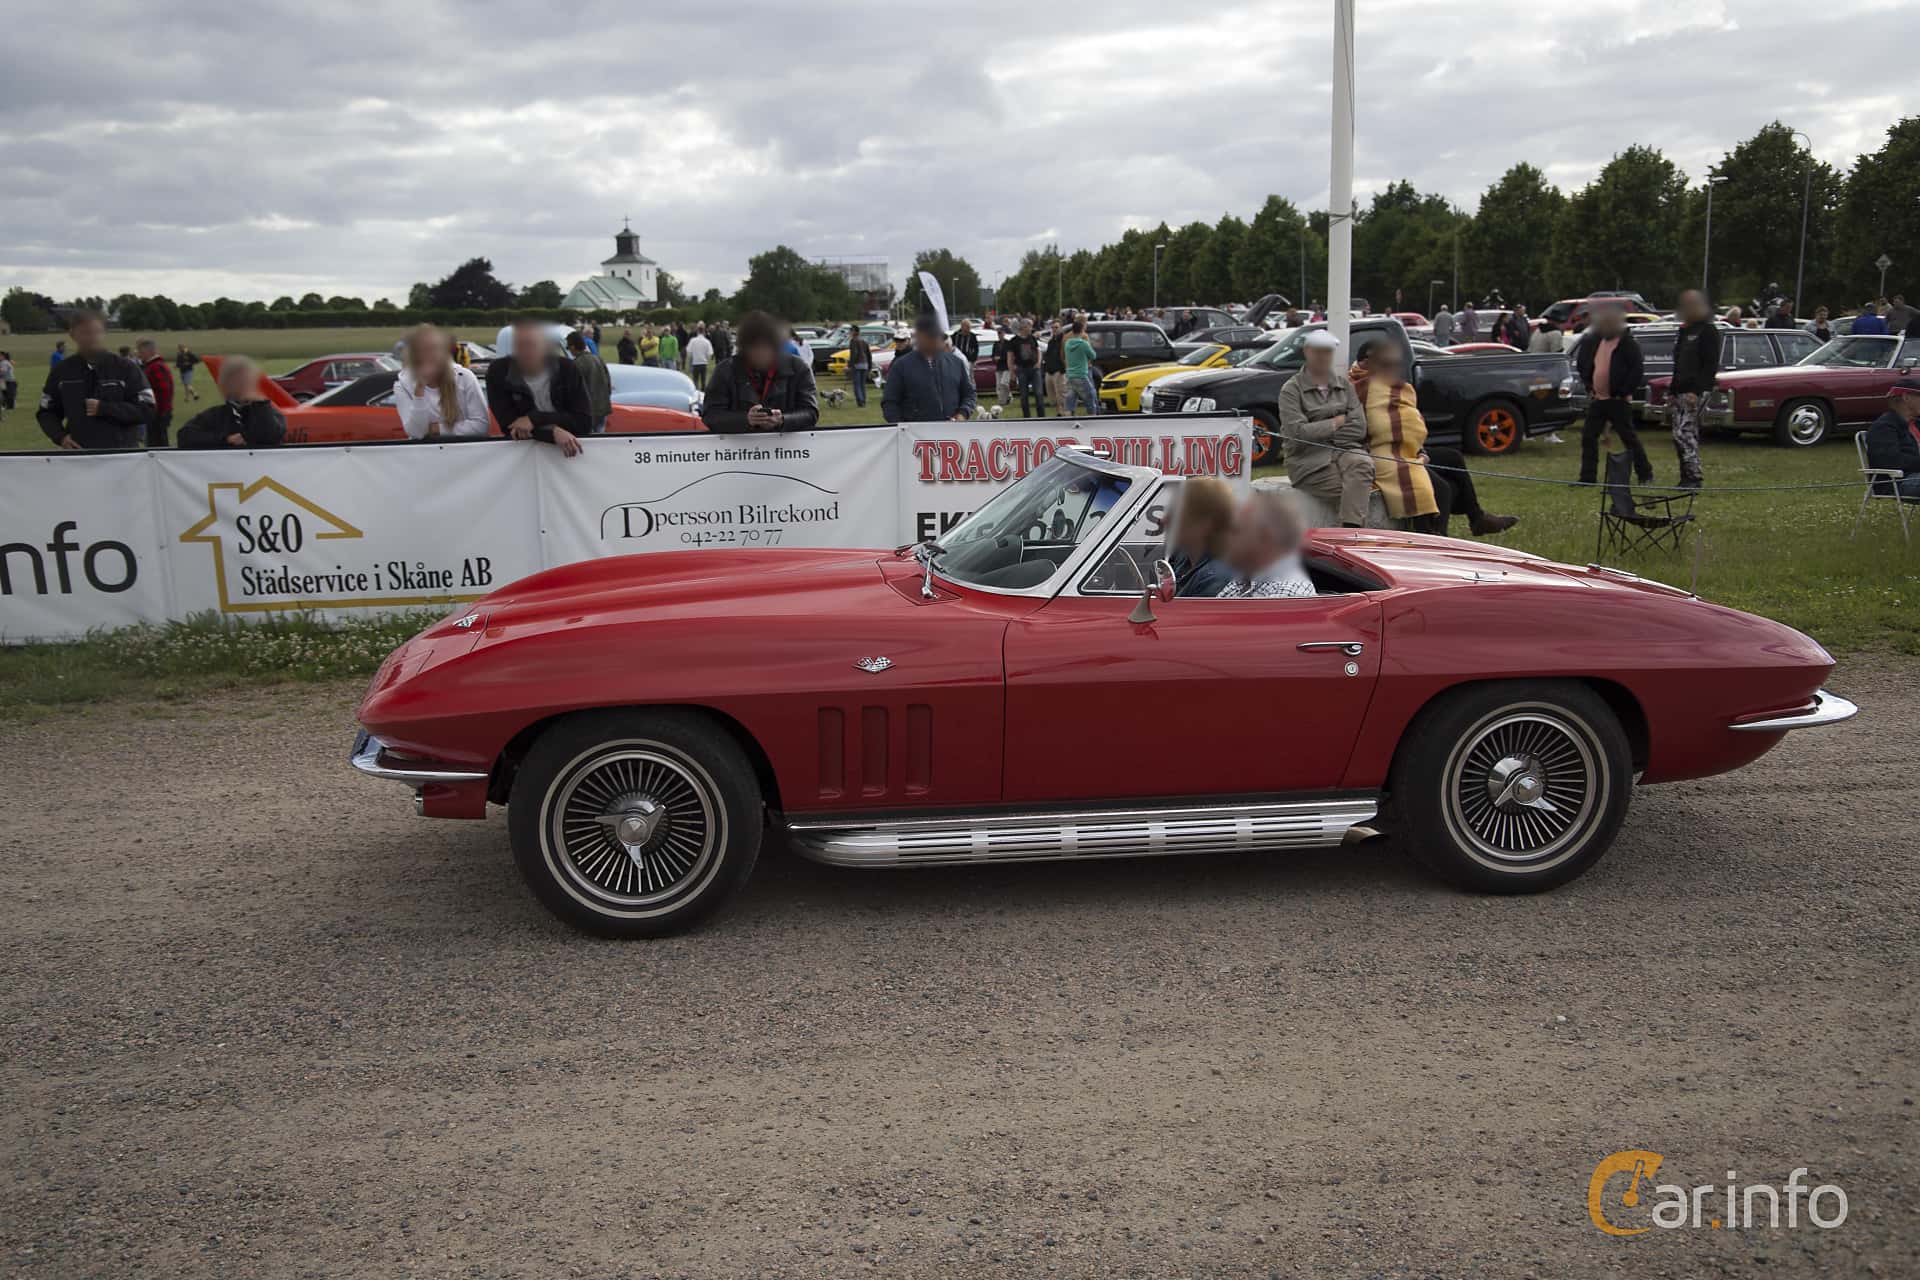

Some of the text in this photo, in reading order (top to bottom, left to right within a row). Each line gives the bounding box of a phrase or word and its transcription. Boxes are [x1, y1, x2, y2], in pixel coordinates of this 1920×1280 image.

[634, 447, 810, 464] 38 minuter härifrån finns
[913, 434, 1243, 481] TRACTO PULLING
[738, 501, 840, 526] Bilrekond
[236, 513, 303, 555] S&O
[680, 528, 783, 547] 042-22 70 77
[240, 556, 493, 597] Städservice i Skåne AB
